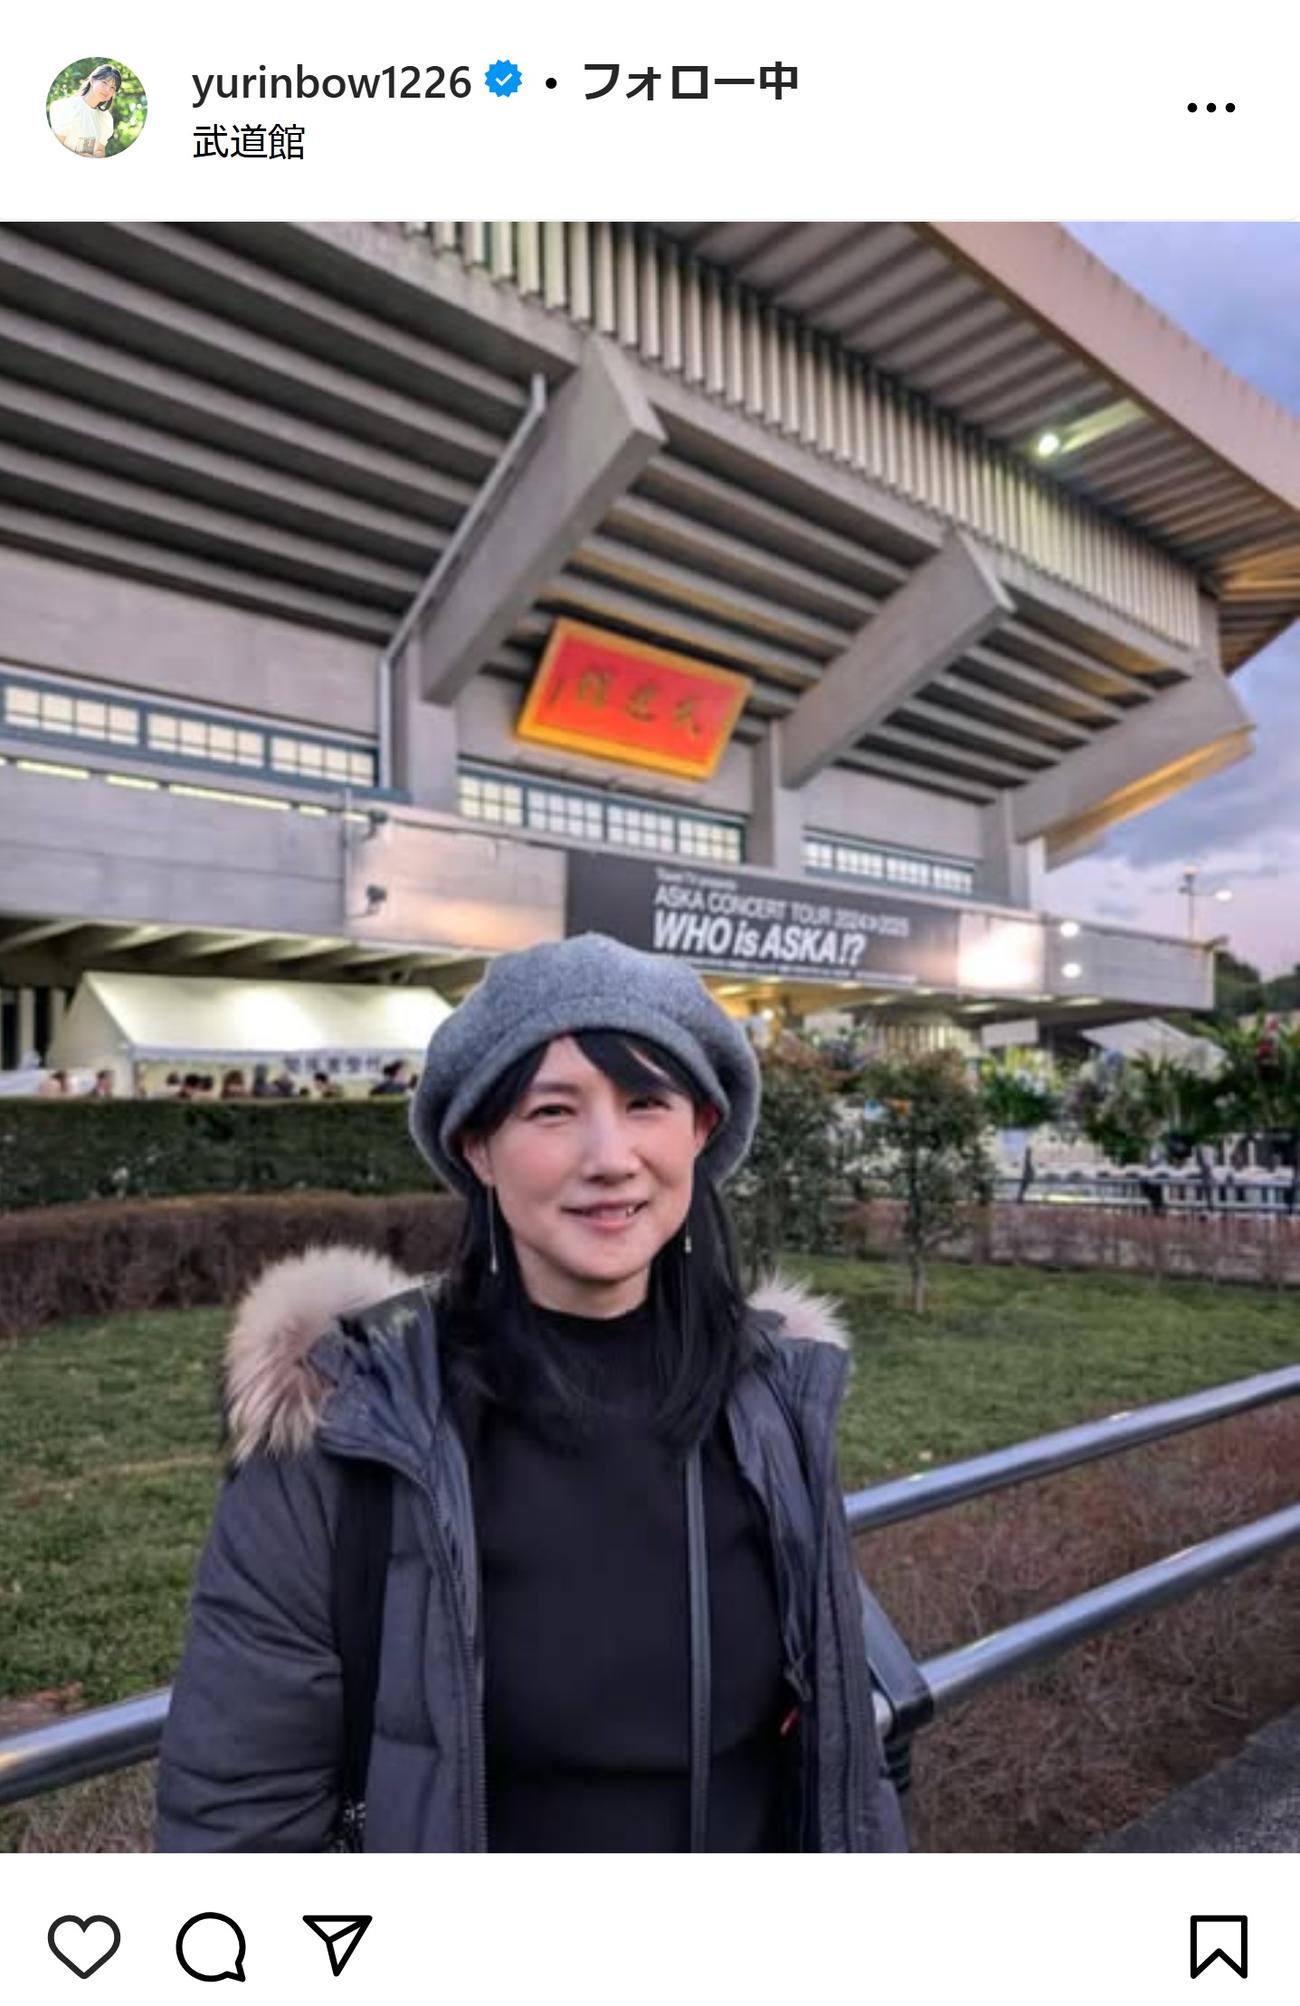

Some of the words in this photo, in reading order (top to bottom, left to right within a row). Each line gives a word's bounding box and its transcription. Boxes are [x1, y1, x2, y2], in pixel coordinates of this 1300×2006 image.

[654, 883, 706, 911] ASKA
[653, 908, 734, 955] WHO
[732, 919, 761, 958] is
